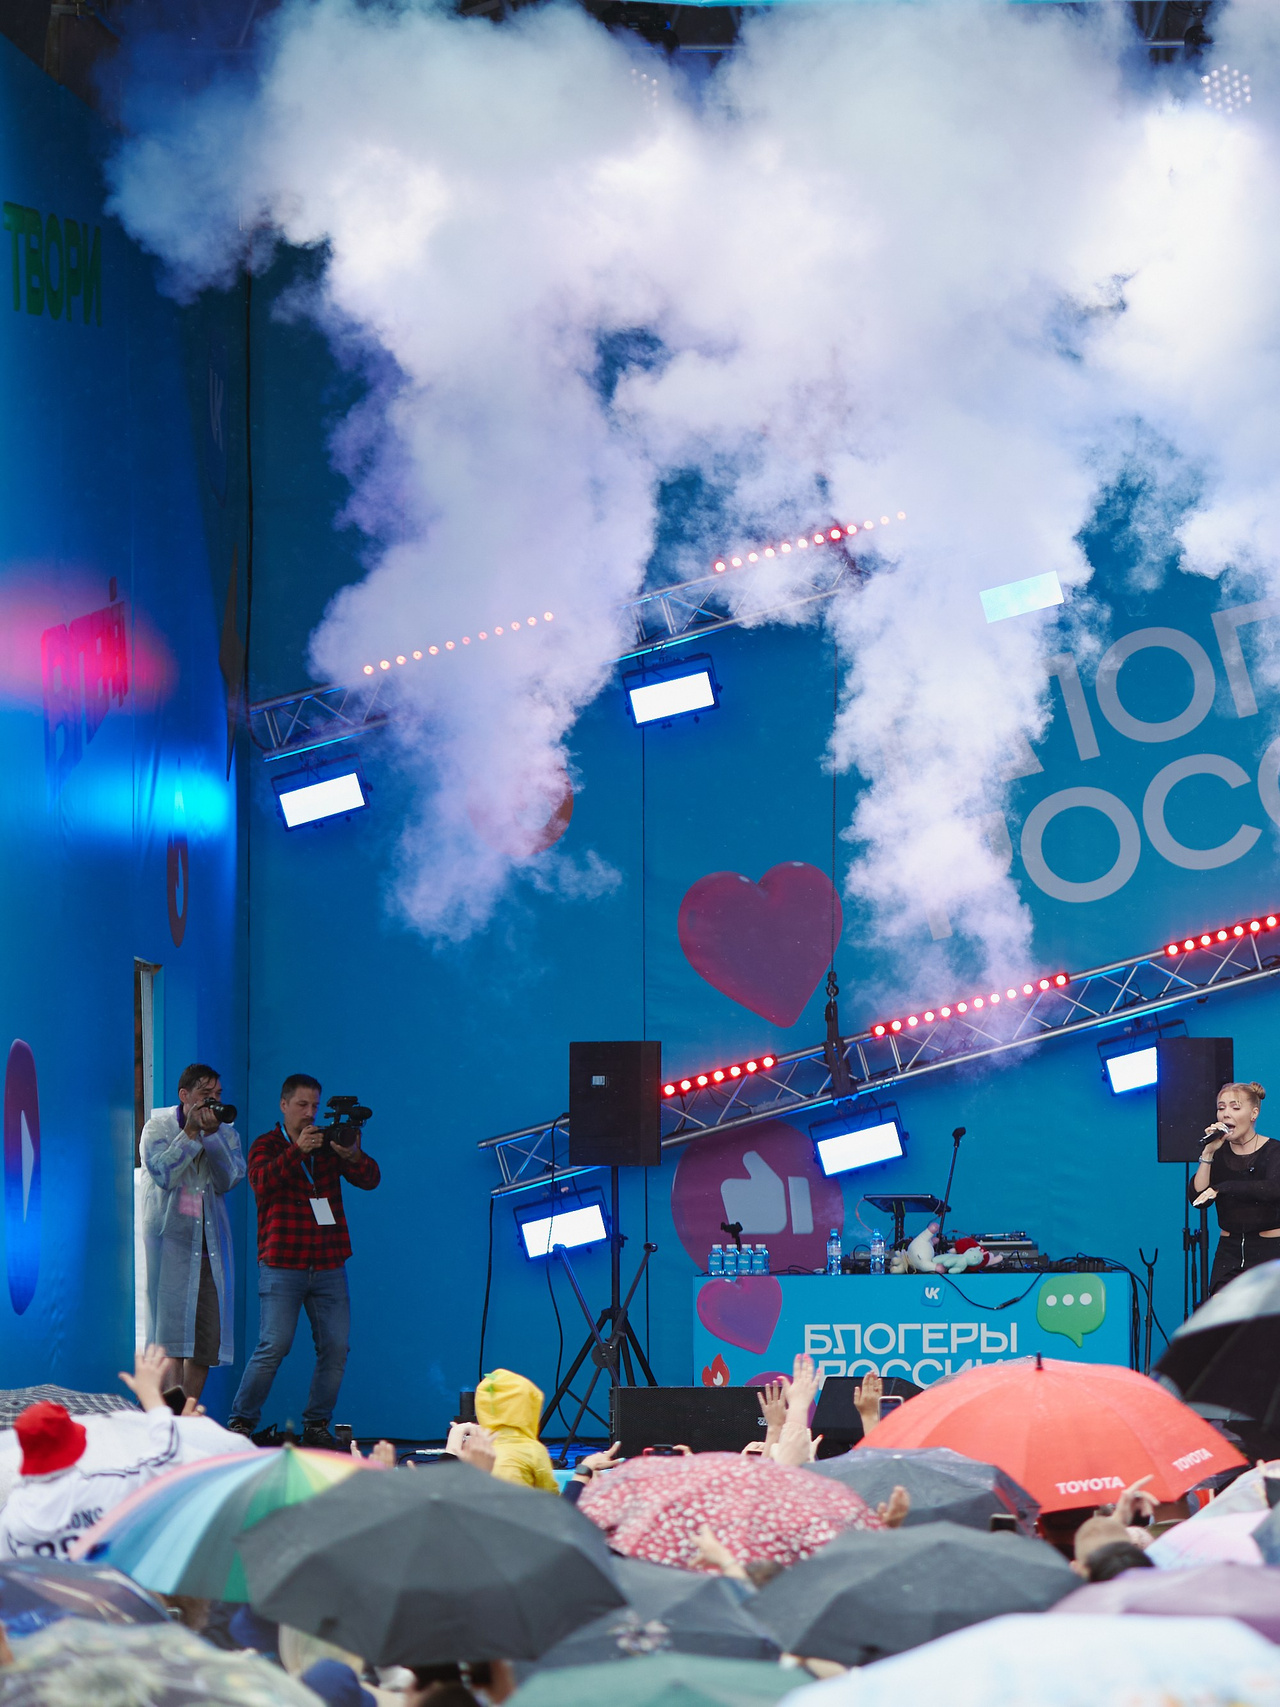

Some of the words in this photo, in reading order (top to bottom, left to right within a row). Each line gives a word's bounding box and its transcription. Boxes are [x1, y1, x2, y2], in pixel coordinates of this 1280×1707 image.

[4, 201, 102, 328] ТВОРИ
[804, 1322, 1018, 1355] БЛОГЕРЫ
[1172, 1447, 1214, 1473] TOYOTA
[1055, 1475, 1126, 1496] TOYOTA
